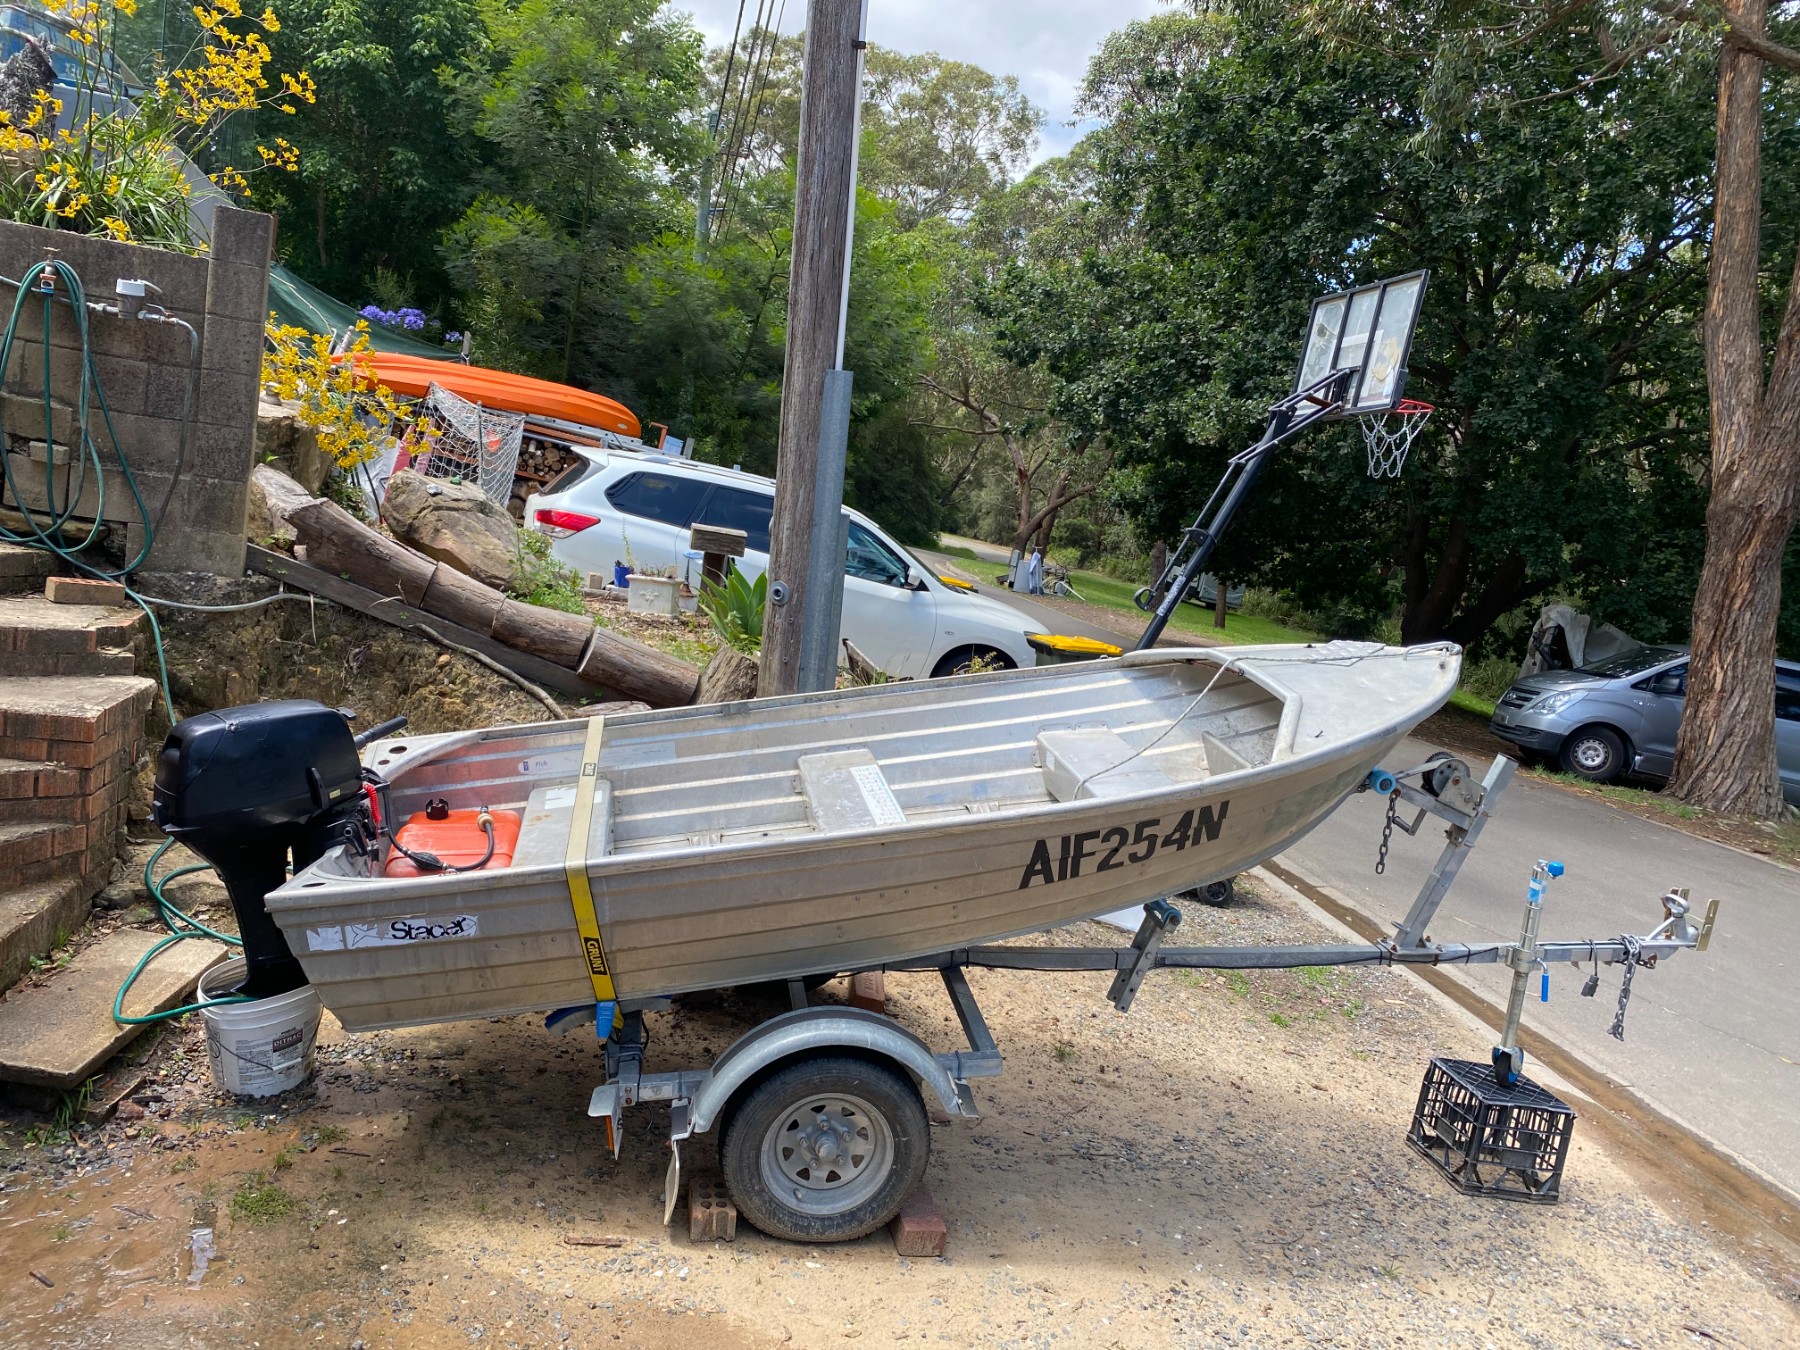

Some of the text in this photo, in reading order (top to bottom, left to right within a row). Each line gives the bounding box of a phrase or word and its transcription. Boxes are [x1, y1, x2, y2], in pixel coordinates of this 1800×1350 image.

[1019, 800, 1230, 889] AIF254N
[391, 917, 466, 939] Stacer
[587, 940, 604, 972] GRUNT
